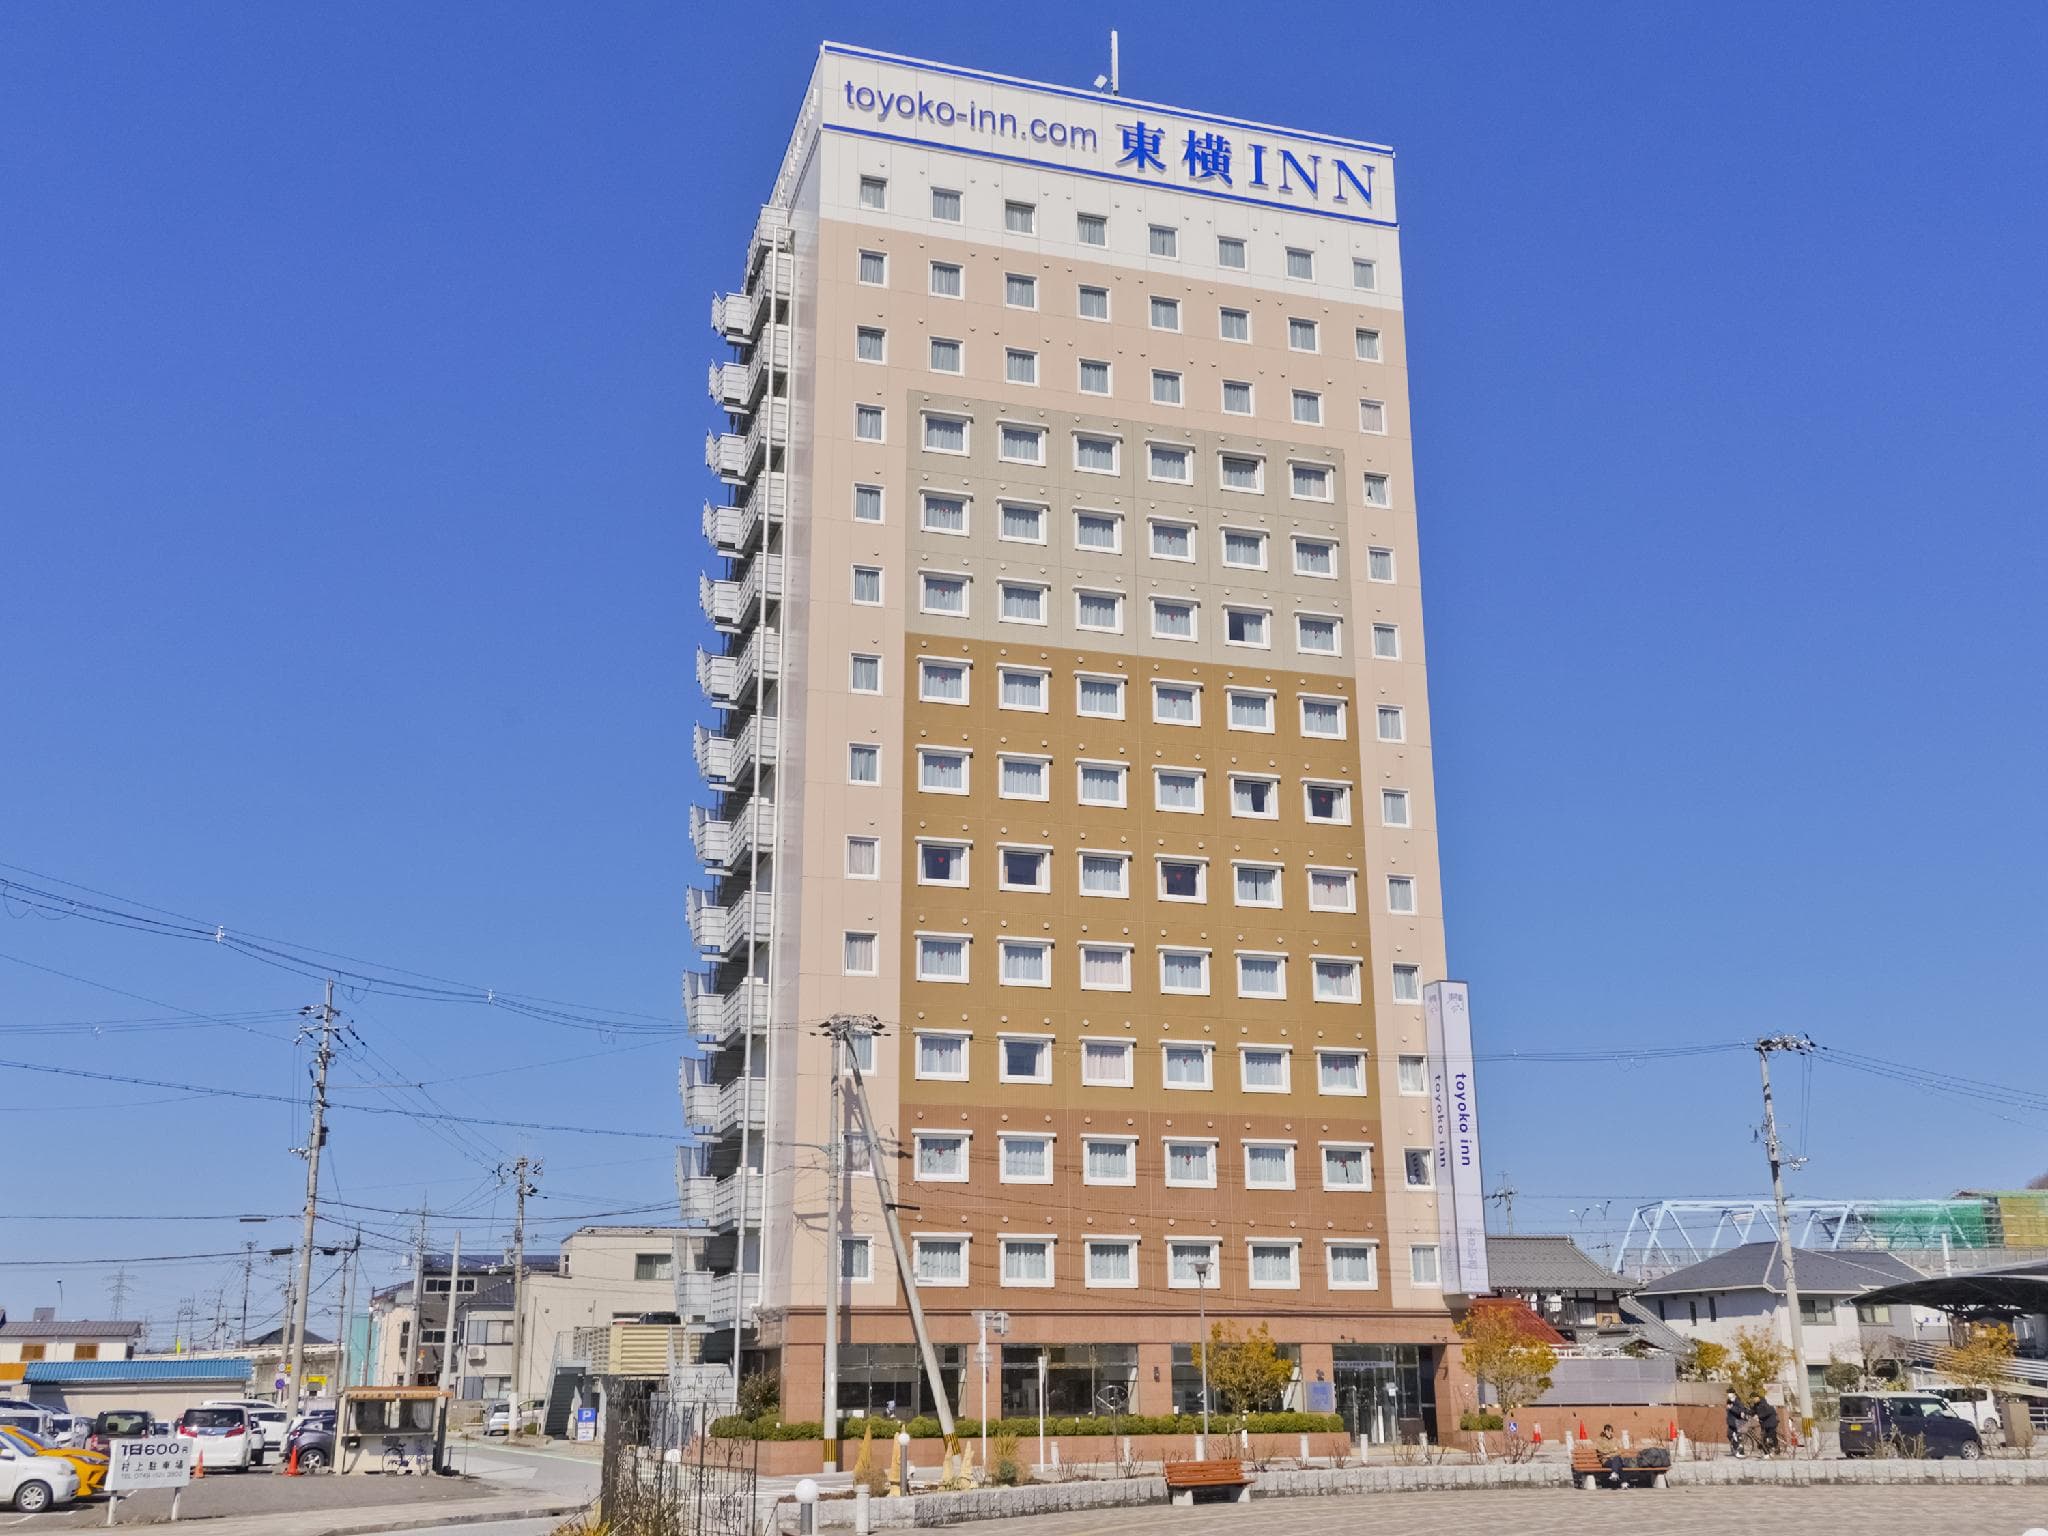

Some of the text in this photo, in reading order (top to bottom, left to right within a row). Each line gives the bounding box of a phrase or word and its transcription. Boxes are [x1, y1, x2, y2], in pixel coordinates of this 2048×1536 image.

[844, 80, 1098, 152] toyoko-inn.com
[1434, 1074, 1444, 1134] toyoko
[1455, 1073, 1472, 1166] toyoko inn
[582, 1411, 592, 1421] P
